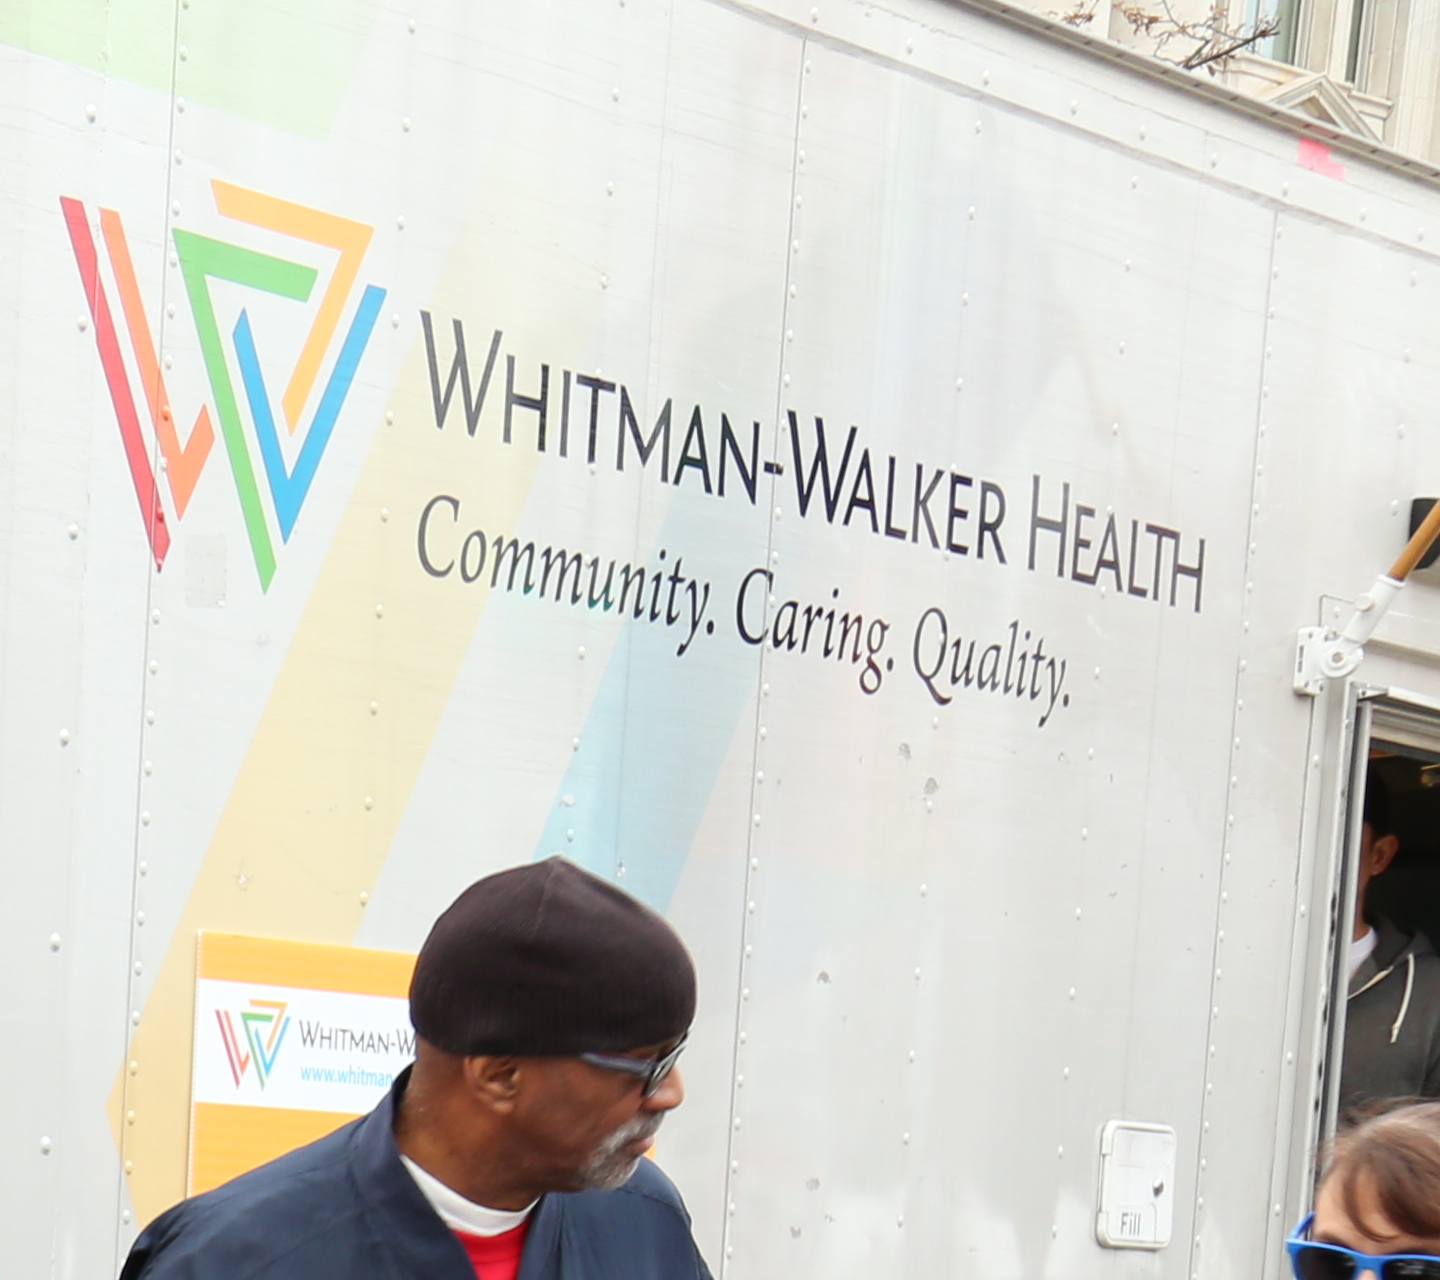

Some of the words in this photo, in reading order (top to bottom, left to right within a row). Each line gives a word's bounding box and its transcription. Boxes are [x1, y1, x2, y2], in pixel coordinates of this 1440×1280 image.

[420, 309, 1007, 564] WHITMAN-WALKER
[1028, 473, 1206, 613] HEALTH
[416, 493, 715, 657] Community.
[736, 568, 894, 694] Caring.
[913, 606, 1071, 728] Quality.
[1121, 1212, 1141, 1236] Fill
